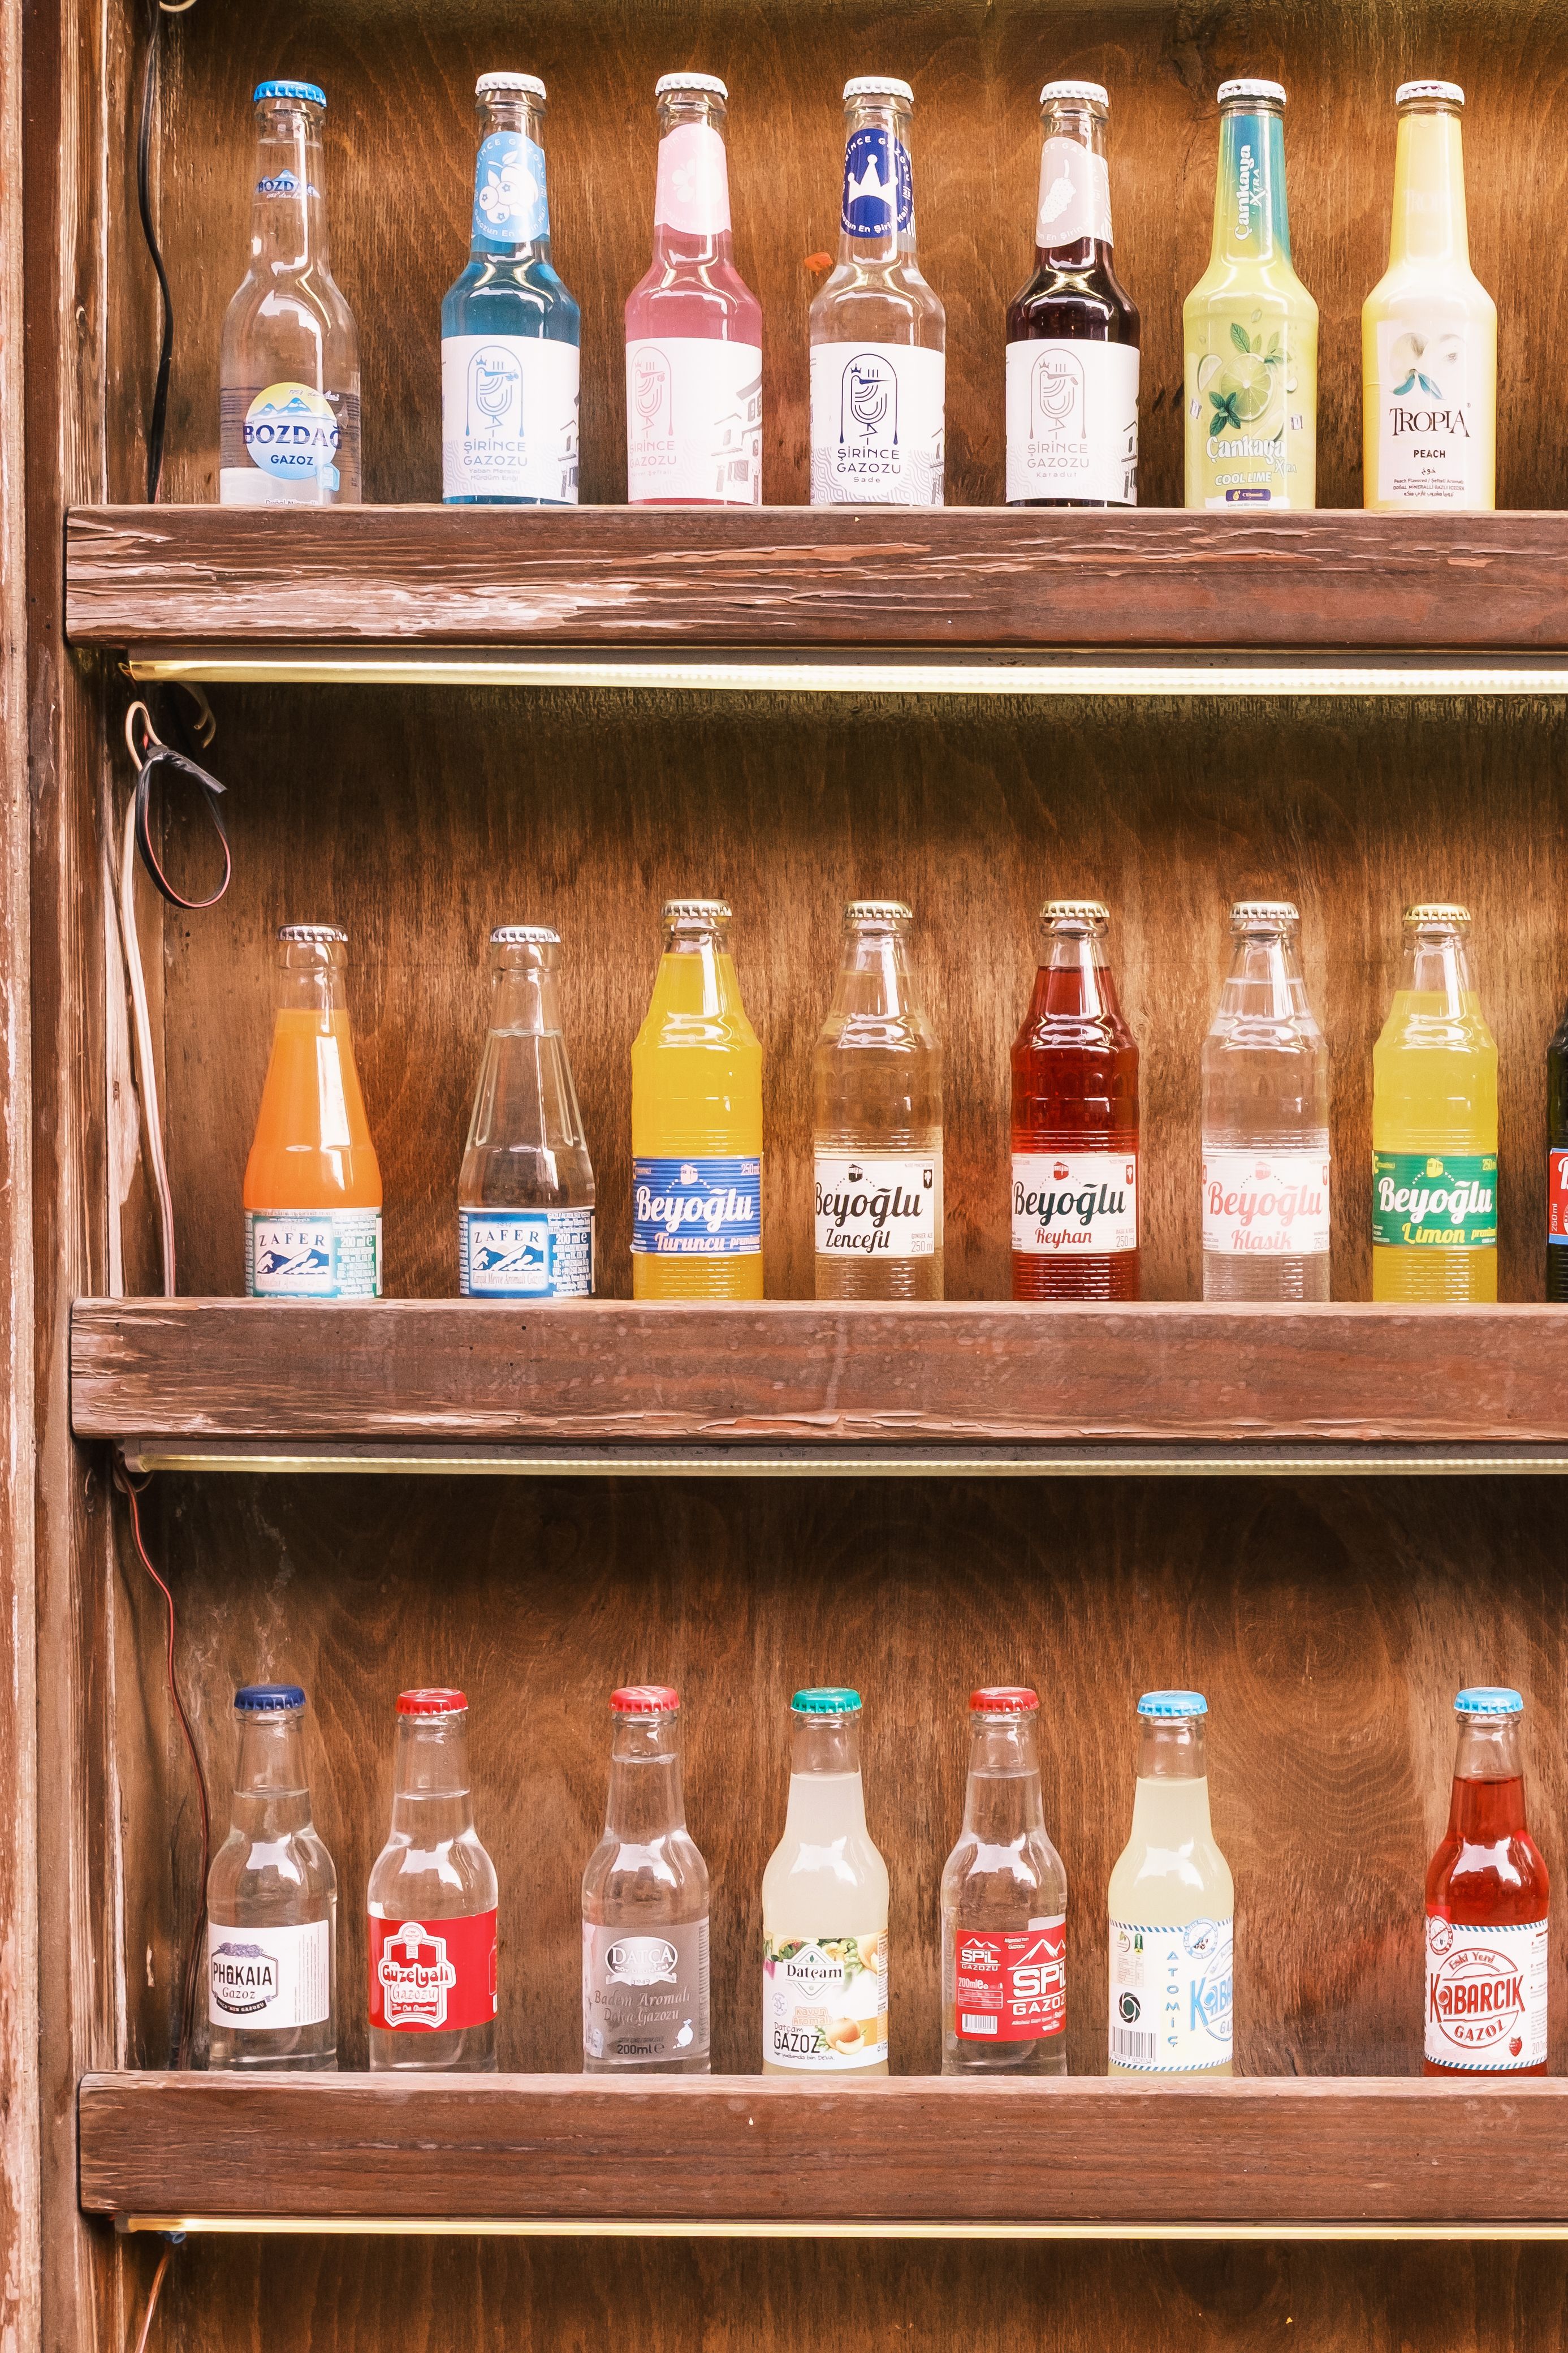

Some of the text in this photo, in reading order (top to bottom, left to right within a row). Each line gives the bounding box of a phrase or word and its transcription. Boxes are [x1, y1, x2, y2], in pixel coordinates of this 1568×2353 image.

[1234, 145, 1255, 240] Çankaya
[1389, 407, 1470, 438] TROPIA
[243, 425, 342, 449] BOZDAĞ
[464, 438, 525, 454] ŞİRİNCE
[837, 446, 900, 461] ŞİRİNCE
[1027, 441, 1088, 456] ŞİRİNCE
[1206, 434, 1286, 465] Çankaya
[1414, 450, 1445, 458] PEACH
[271, 455, 313, 466] GAZOZ
[464, 455, 528, 467] GAZOZU
[630, 455, 676, 468] GAZOZU
[837, 463, 901, 474] GAZOZU
[1027, 458, 1089, 468] GAZOZU
[1215, 472, 1272, 486] COOL LIME
[636, 1186, 754, 1232] Beyoğlu
[815, 1182, 923, 1228] Beyoğlu
[1014, 1181, 1126, 1226] Beyoğlu
[1208, 1181, 1323, 1227] Beyoğlu
[1379, 1177, 1493, 1225] Beyoğlu
[259, 1232, 325, 1247] ZAFER
[340, 1236, 356, 1247] 200
[474, 1229, 539, 1243] ZAFER
[556, 1234, 571, 1245] 200
[654, 1232, 725, 1252] Turuncu
[826, 1228, 891, 1253] Zencefil
[1035, 1227, 1092, 1249] Reyhan
[1116, 1235, 1128, 1247] 250
[1231, 1229, 1292, 1250] Klasik
[1402, 1222, 1466, 1244] Limon
[912, 1241, 925, 1252] 250
[213, 1962, 273, 1986] PHOKAIA
[787, 1964, 843, 1981] Datçam
[222, 1987, 256, 1999] Gazoz
[1013, 1992, 1066, 2016] GAZOZ
[1454, 2019, 1507, 2041] GAZOZ
[774, 2030, 820, 2053] GAZOZ
